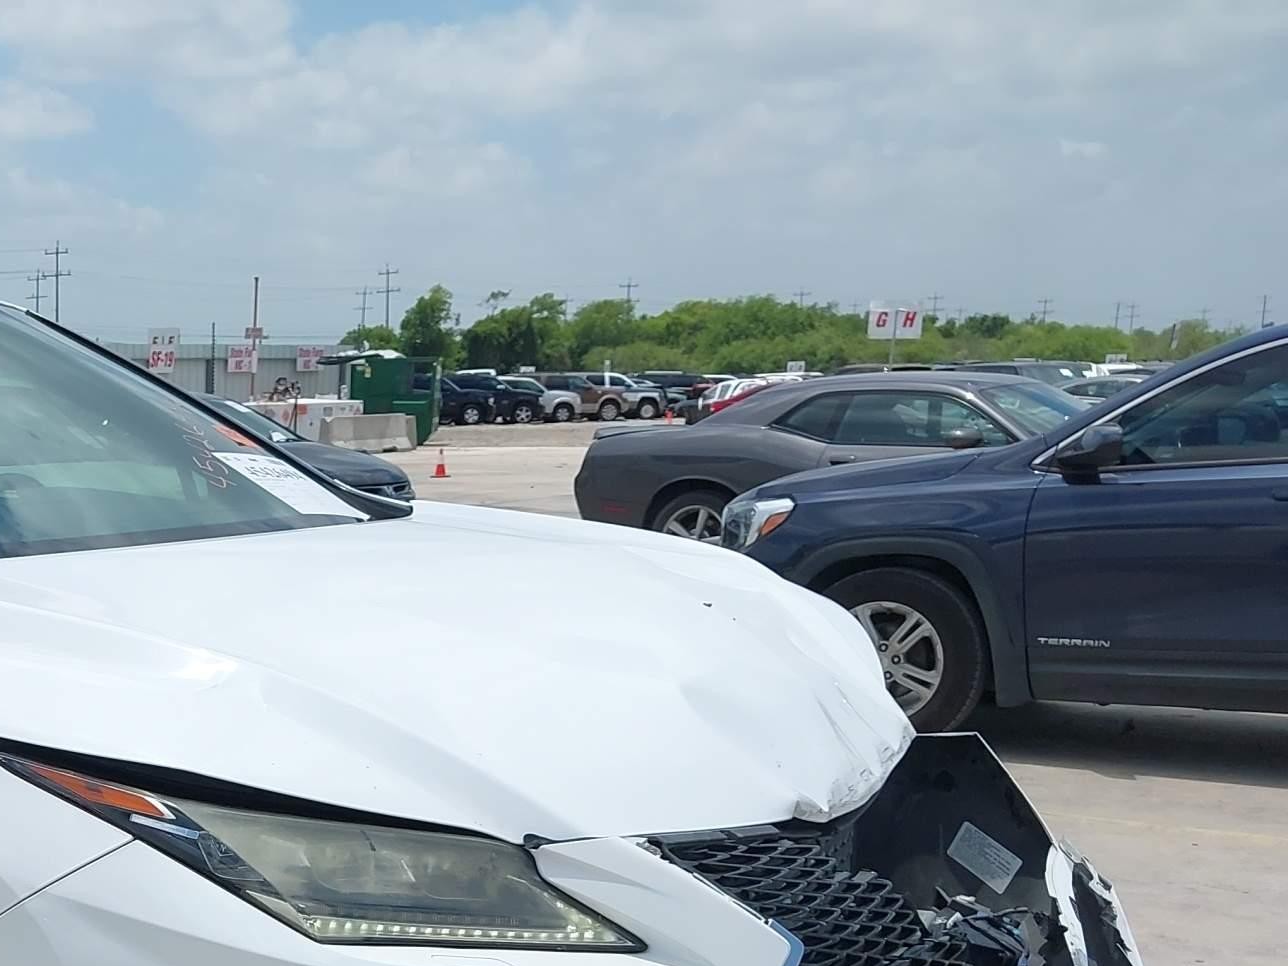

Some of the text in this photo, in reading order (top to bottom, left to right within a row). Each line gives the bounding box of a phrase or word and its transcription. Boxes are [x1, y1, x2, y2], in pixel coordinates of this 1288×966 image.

[876, 311, 917, 328] G H
[1037, 637, 1111, 648] TERRAIN
